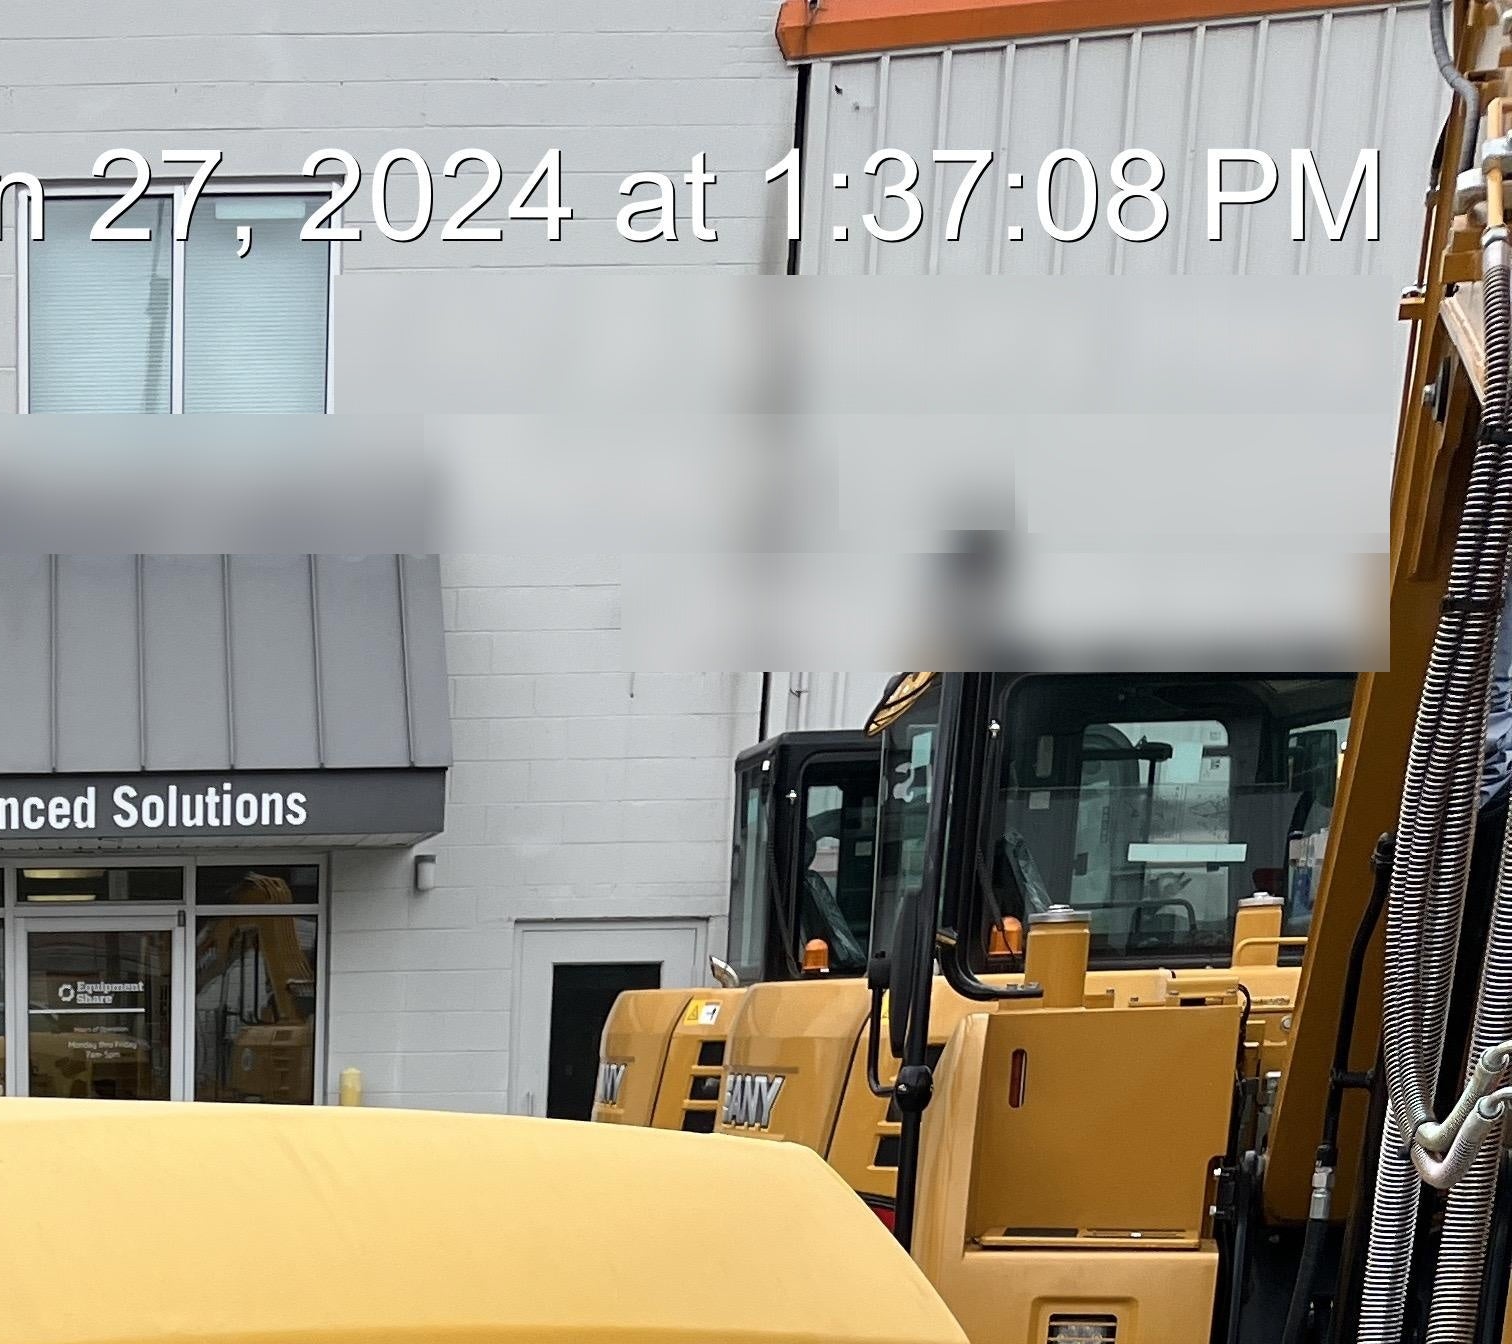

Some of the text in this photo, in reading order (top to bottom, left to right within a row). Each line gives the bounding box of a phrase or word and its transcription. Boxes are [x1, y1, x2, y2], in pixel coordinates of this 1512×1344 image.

[112, 782, 308, 829] Solutions
[76, 981, 145, 994] Equipment
[75, 993, 114, 1005] Share
